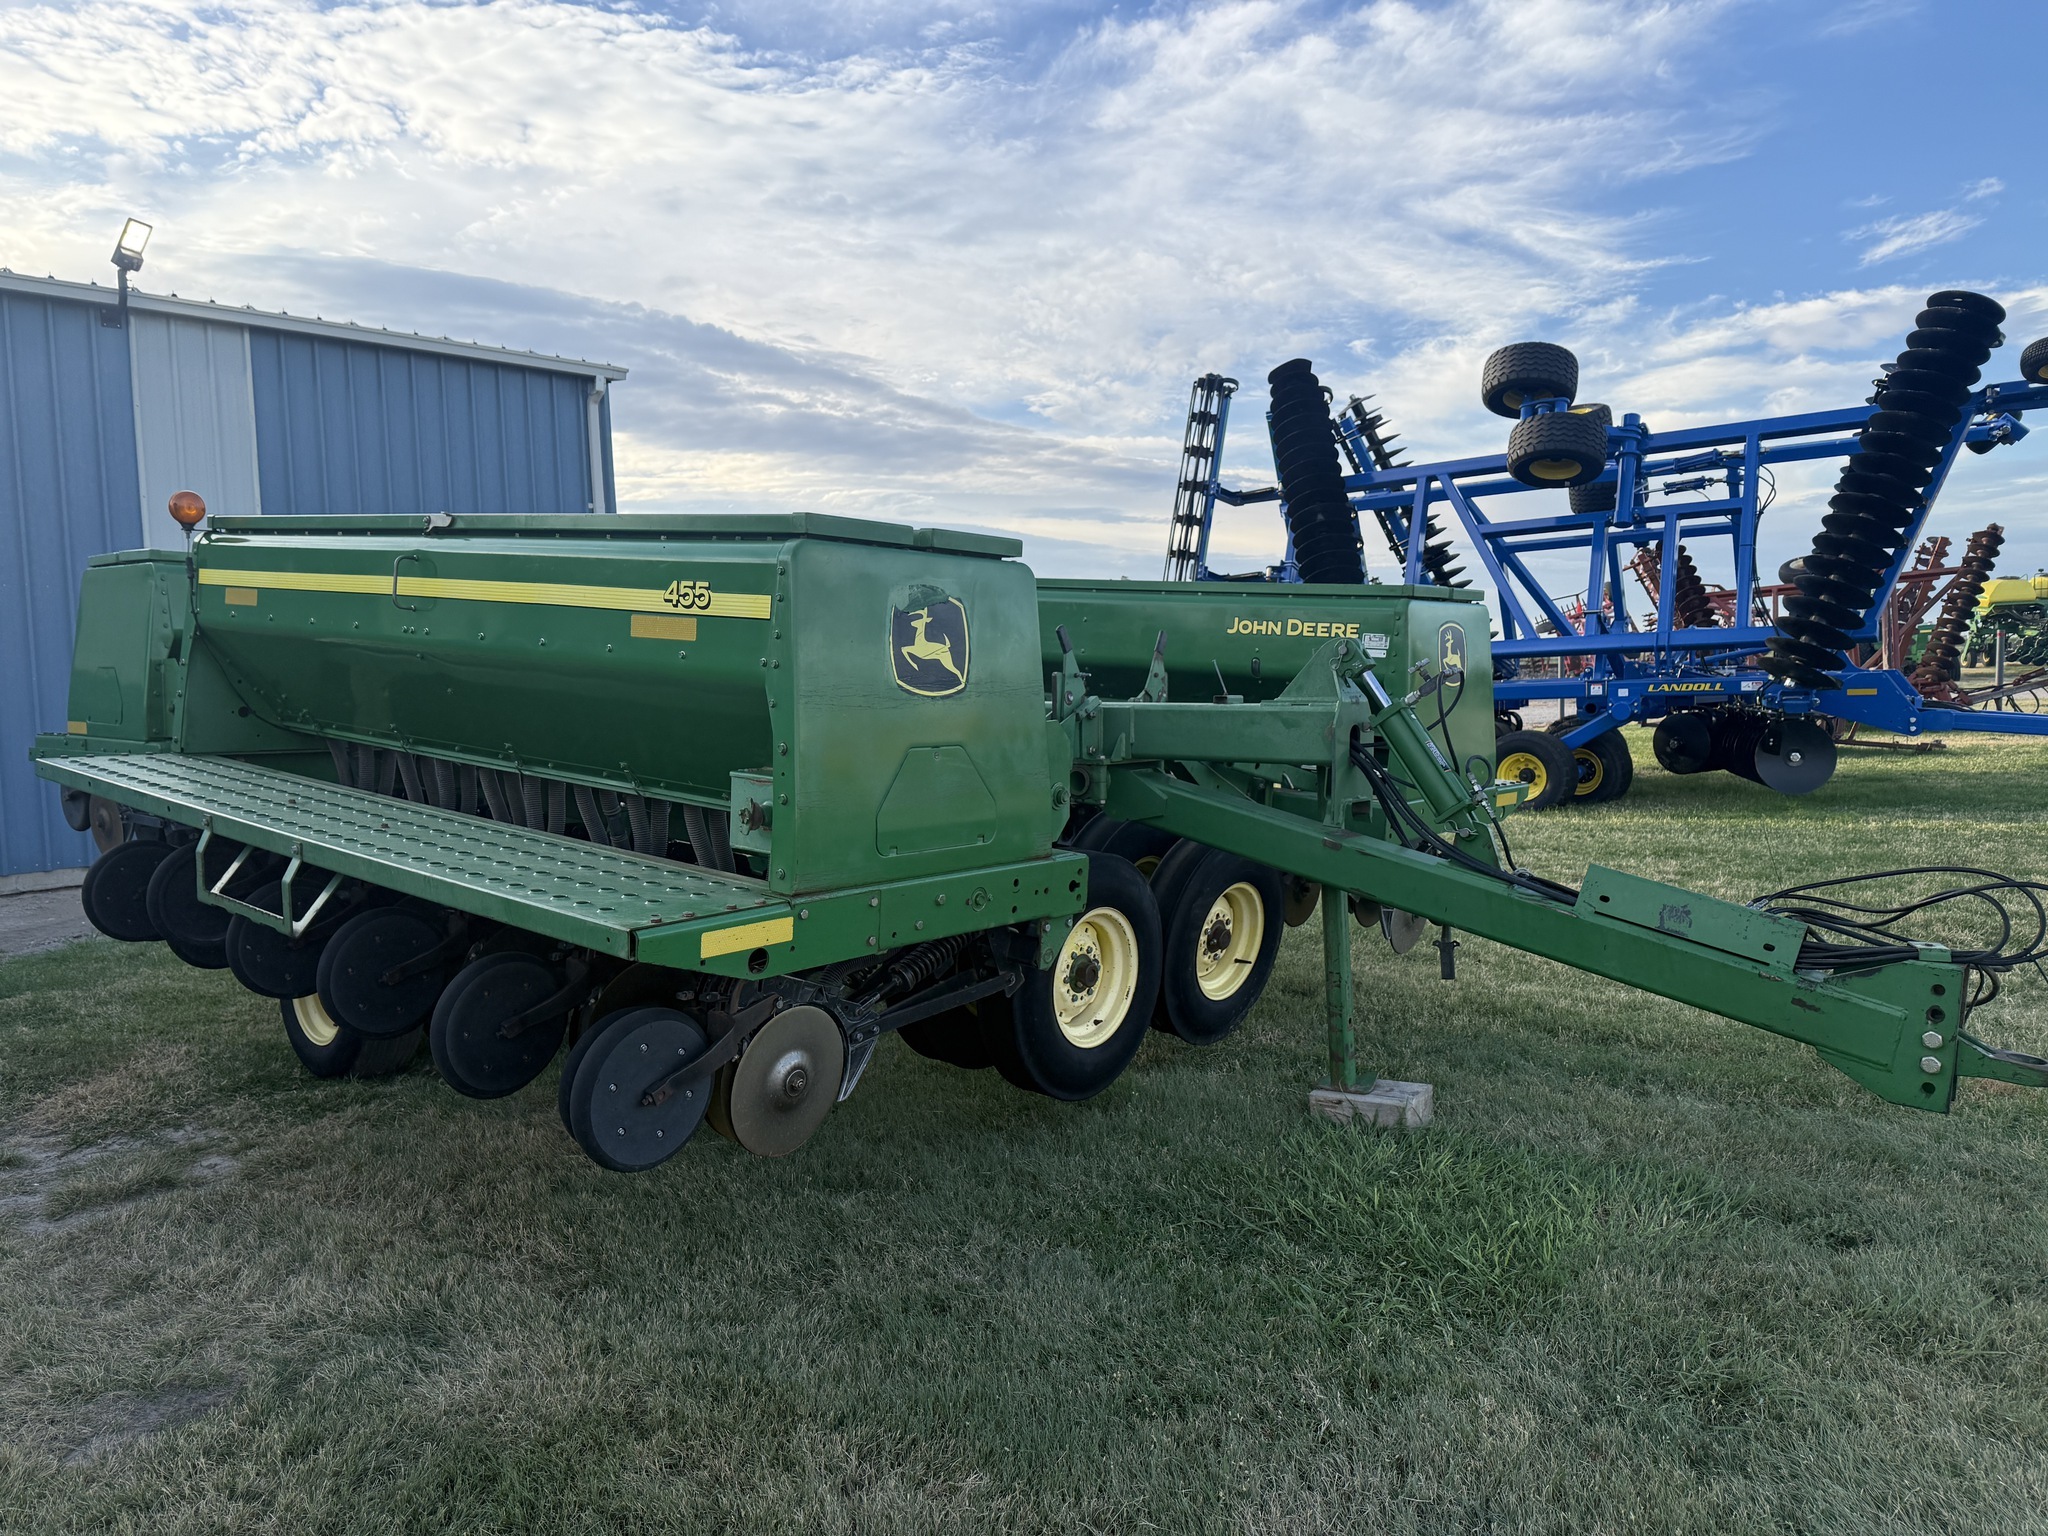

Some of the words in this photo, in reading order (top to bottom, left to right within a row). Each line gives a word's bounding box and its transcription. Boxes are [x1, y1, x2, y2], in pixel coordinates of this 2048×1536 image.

[663, 580, 712, 610] 455
[1226, 616, 1282, 636] JOHN
[1286, 618, 1361, 639] DEERE
[1647, 682, 1725, 693] LANDOLL
